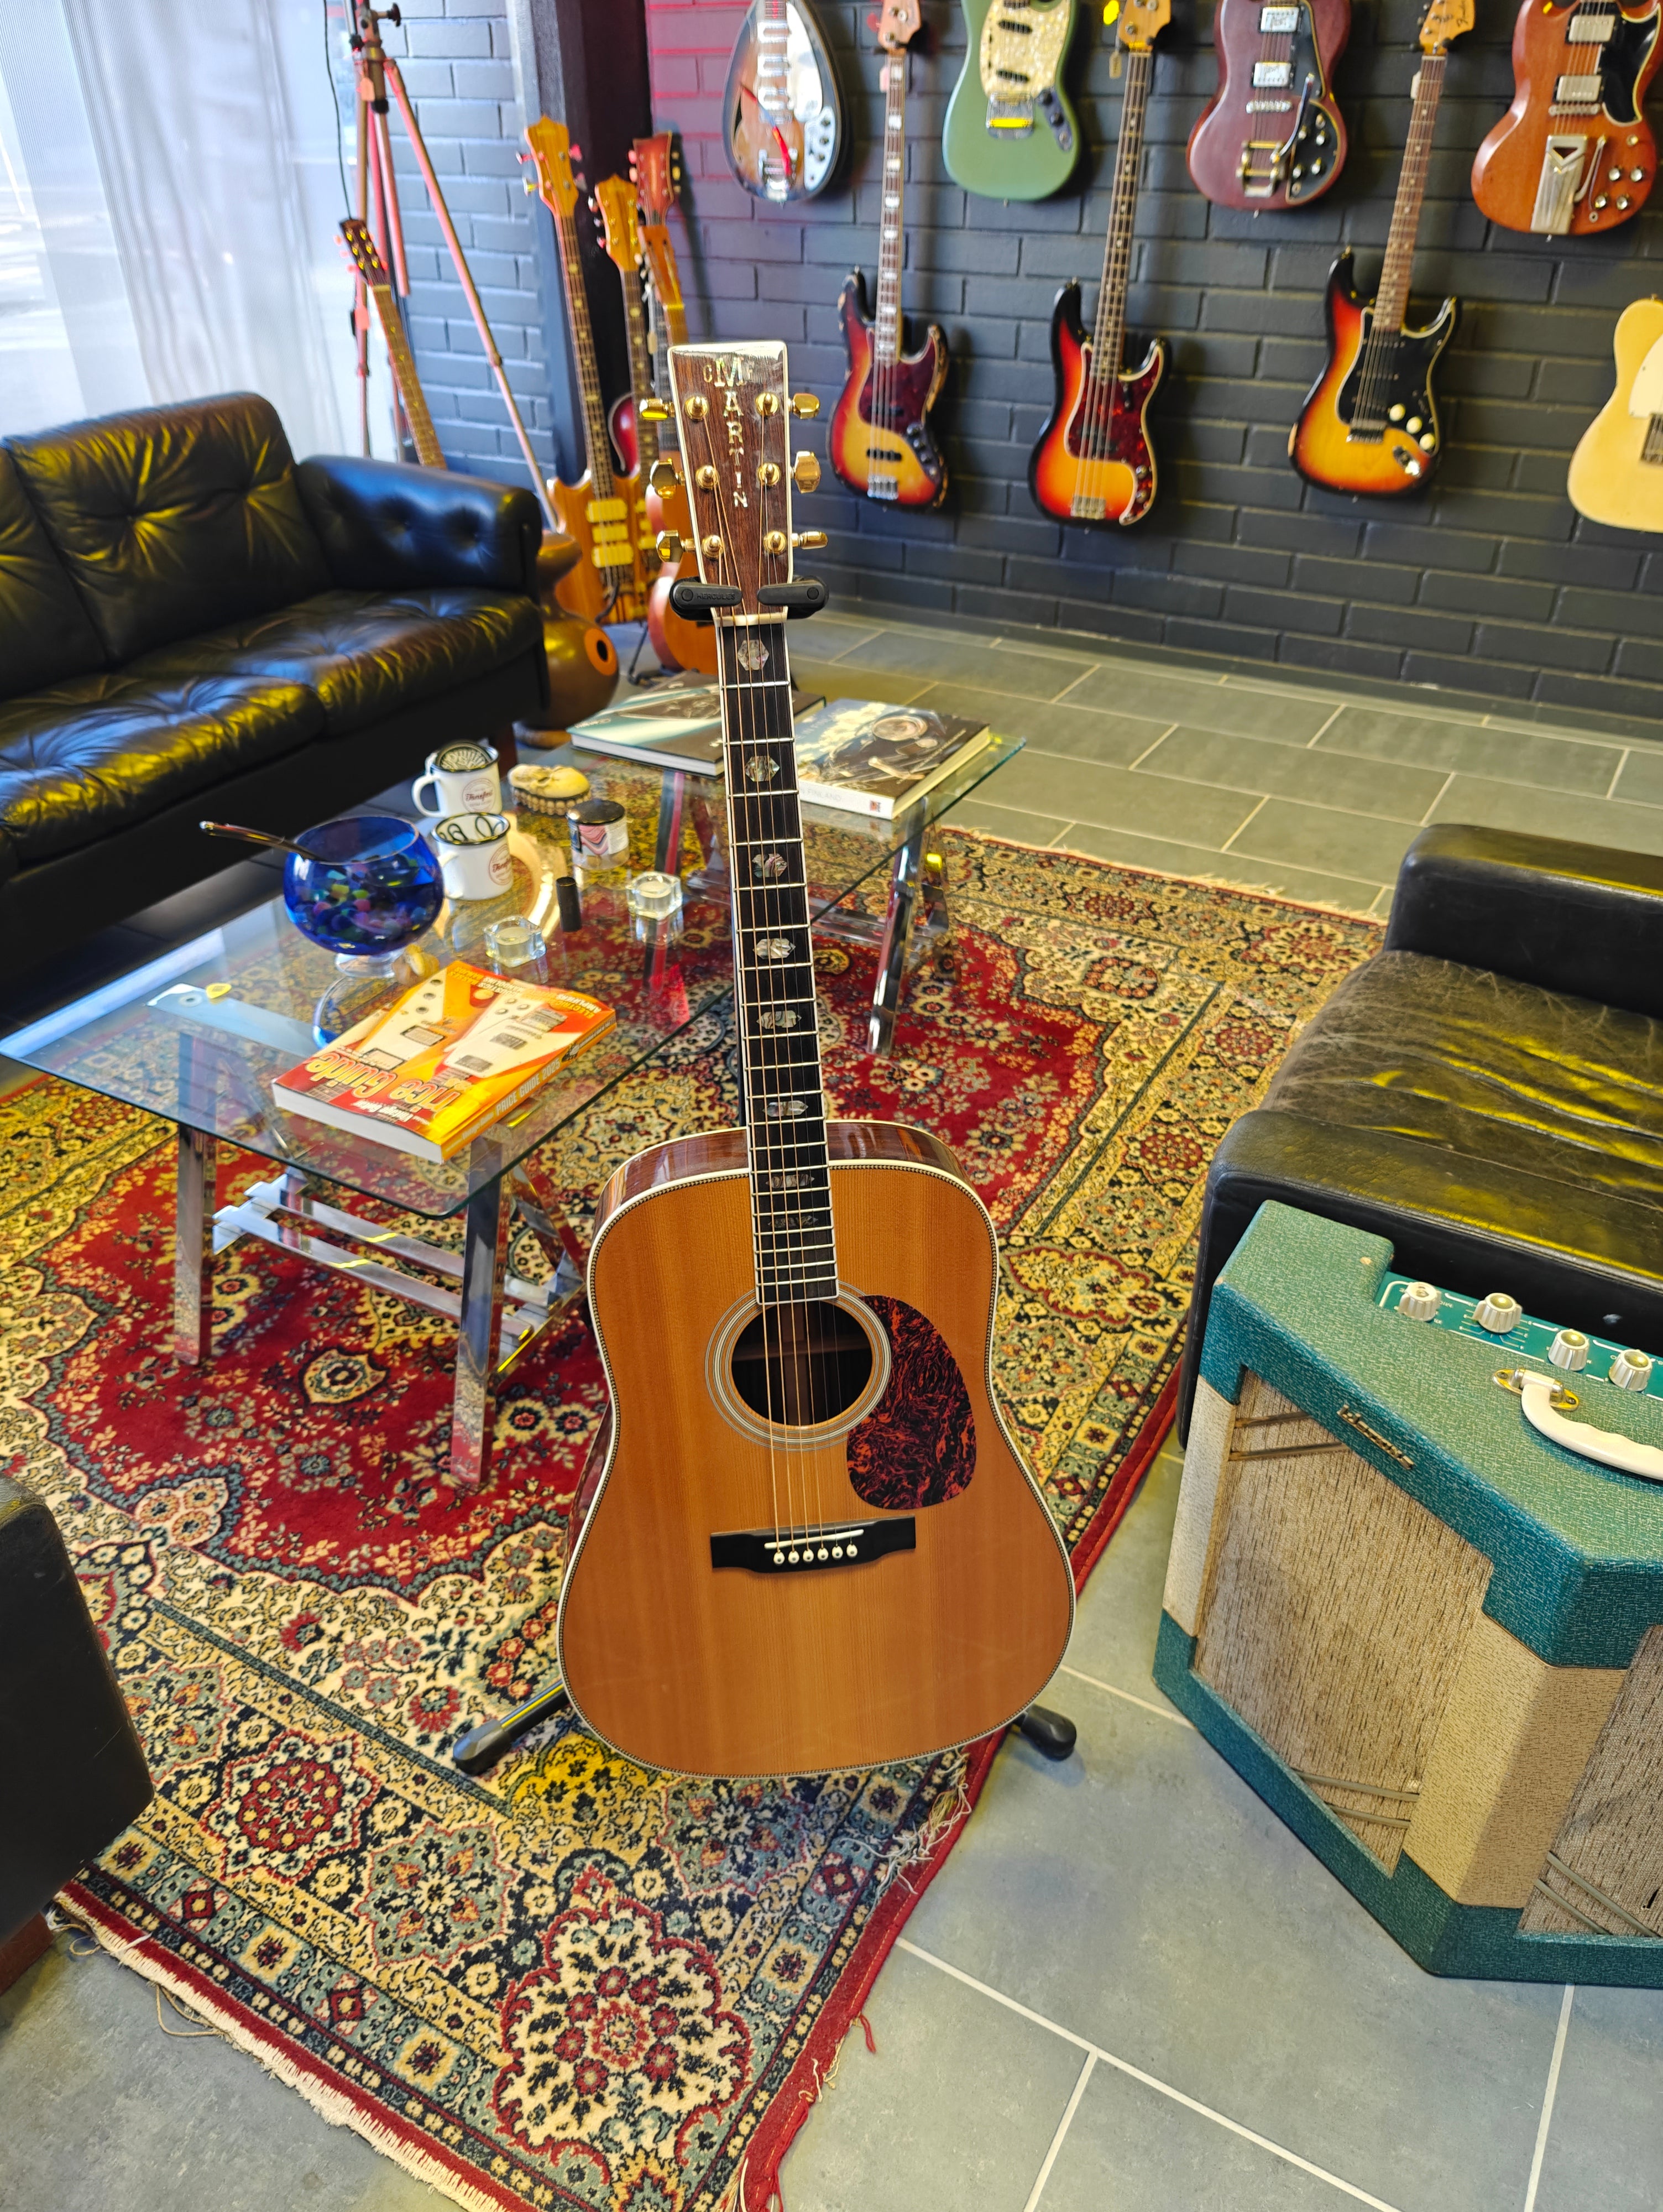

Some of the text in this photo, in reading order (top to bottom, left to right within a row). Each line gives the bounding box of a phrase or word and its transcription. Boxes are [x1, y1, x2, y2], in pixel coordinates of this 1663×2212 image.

[714, 357, 749, 508] MARTIN
[807, 789, 841, 802] FINLAND
[447, 971, 480, 985] BASSES
[454, 967, 484, 980] BANJOS
[483, 976, 525, 993] MANDOLINS
[556, 993, 602, 1014] AMPLIFIERS
[305, 1052, 398, 1098] Guide
[496, 1093, 518, 1116] PRICE
[520, 1075, 541, 1097] GUIDE
[541, 1058, 561, 1081] 2025
[379, 1106, 414, 1123] Vintage
